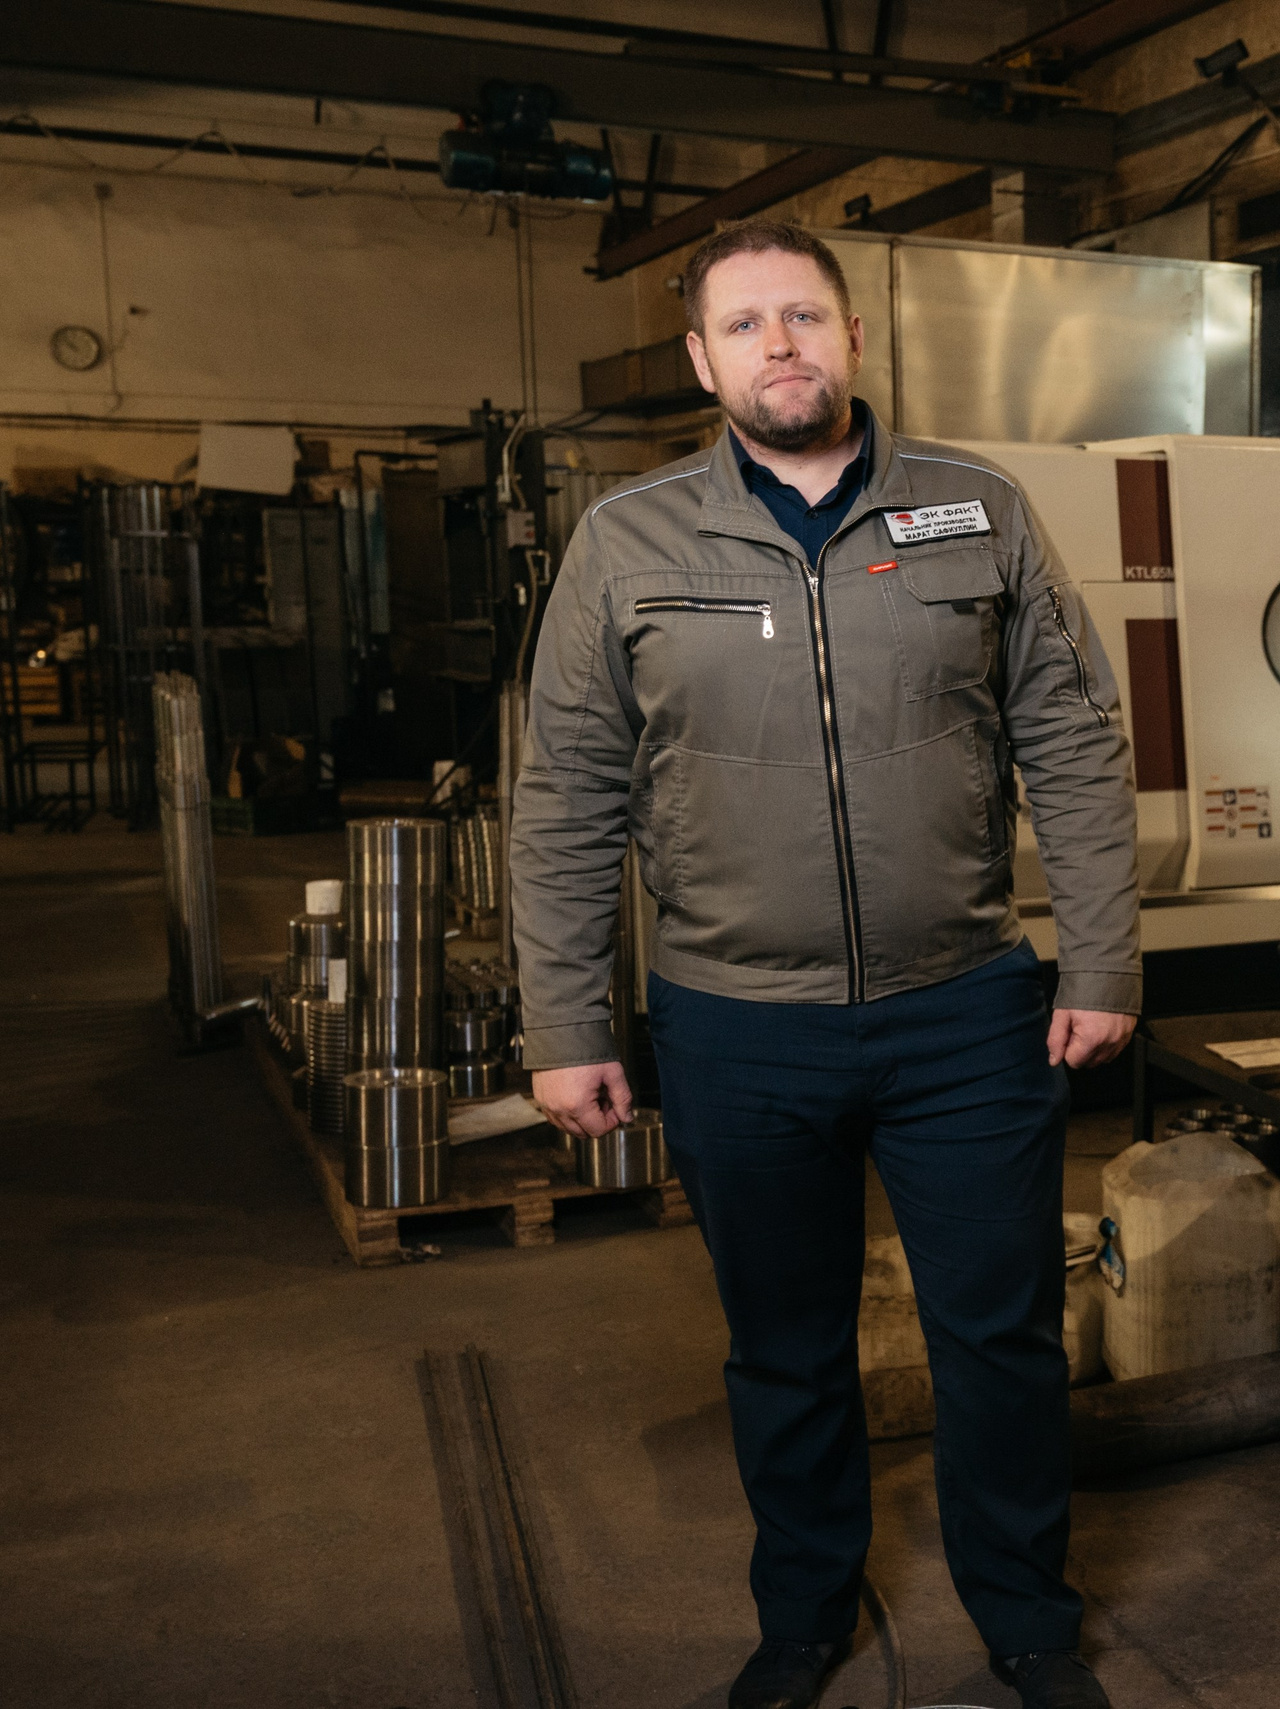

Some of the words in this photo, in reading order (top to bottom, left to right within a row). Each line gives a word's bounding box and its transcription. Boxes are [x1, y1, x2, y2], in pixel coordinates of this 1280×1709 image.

[919, 510, 940, 520] ЭК
[943, 505, 980, 517] ФАКТ
[900, 523, 932, 532] НАЧАЛЬНИК
[933, 517, 977, 527] ПРОИЗВОДСТВА
[905, 530, 931, 540] МАРАТ
[933, 524, 978, 536] САФИУЛЛИН
